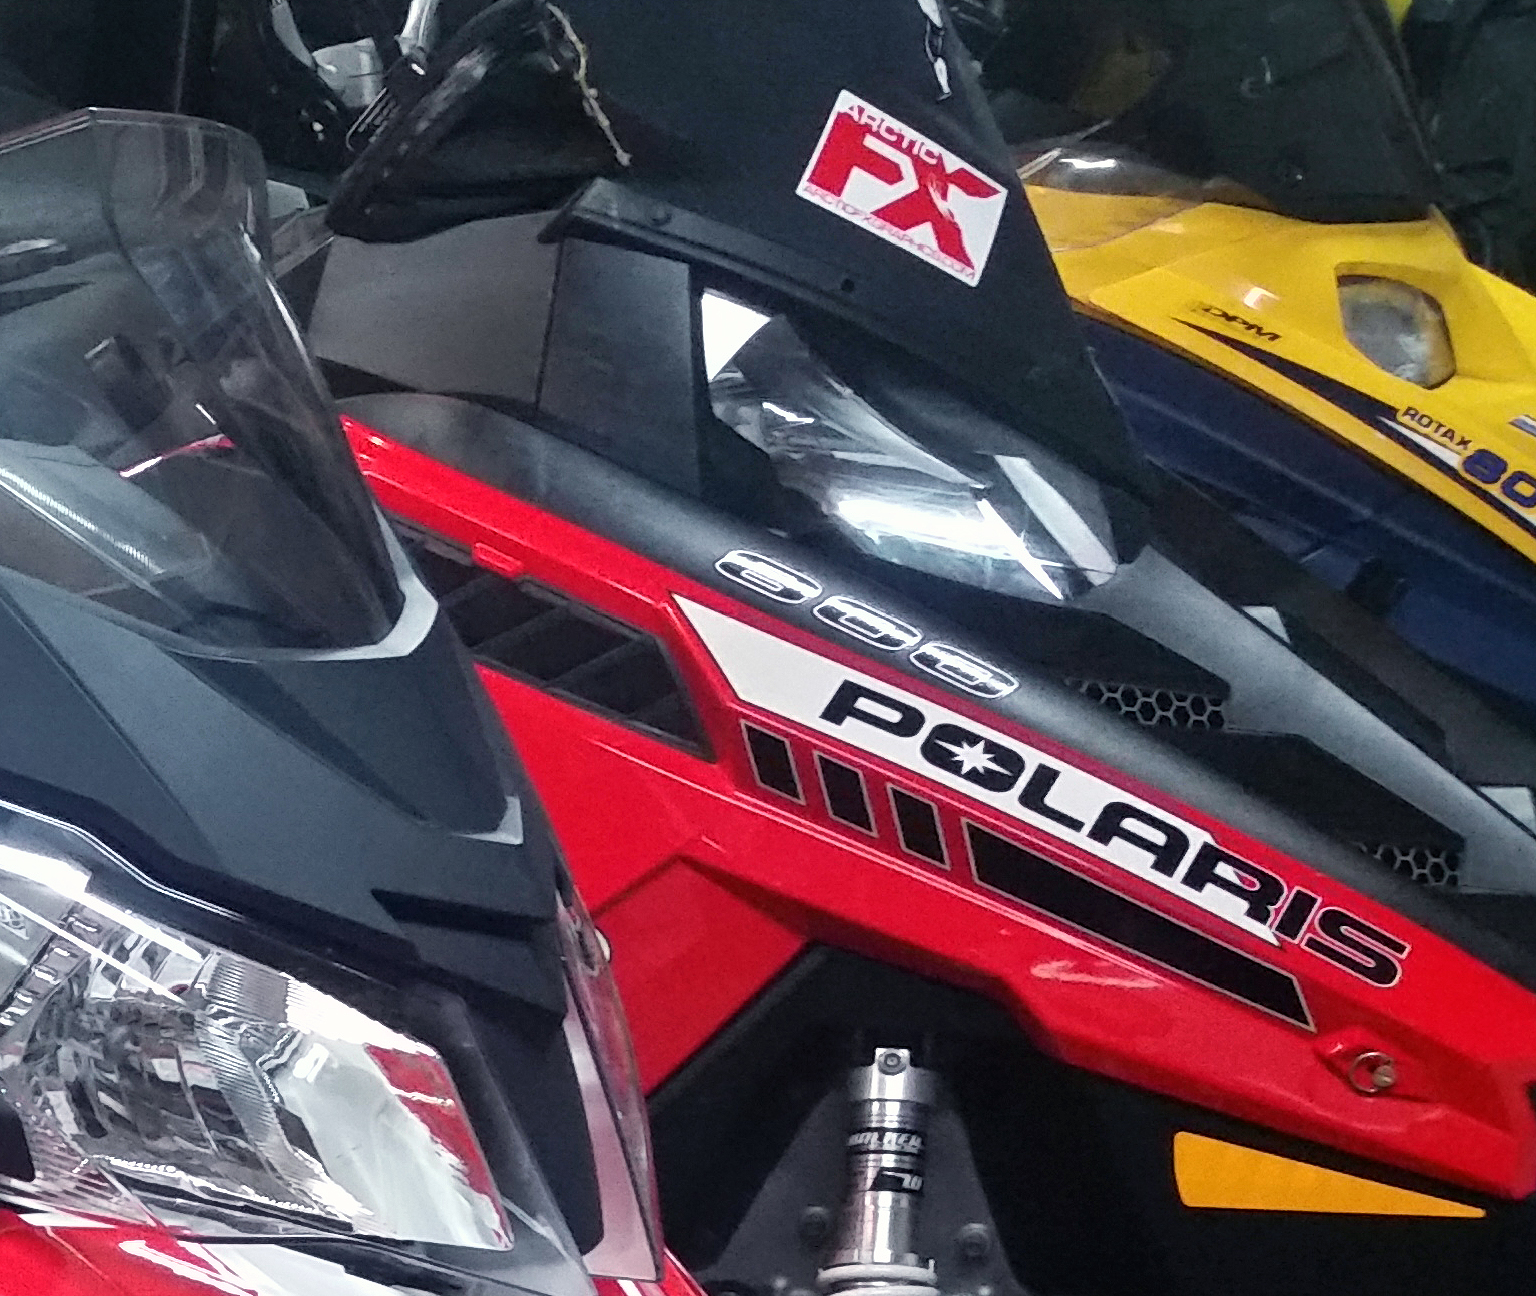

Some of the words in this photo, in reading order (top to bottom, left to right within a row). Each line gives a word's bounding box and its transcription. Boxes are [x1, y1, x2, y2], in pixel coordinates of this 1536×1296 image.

[847, 104, 942, 165] ARCTIC
[806, 111, 1001, 270] FX
[1402, 406, 1473, 451] ROTAX
[819, 680, 1411, 987] POLARIS
